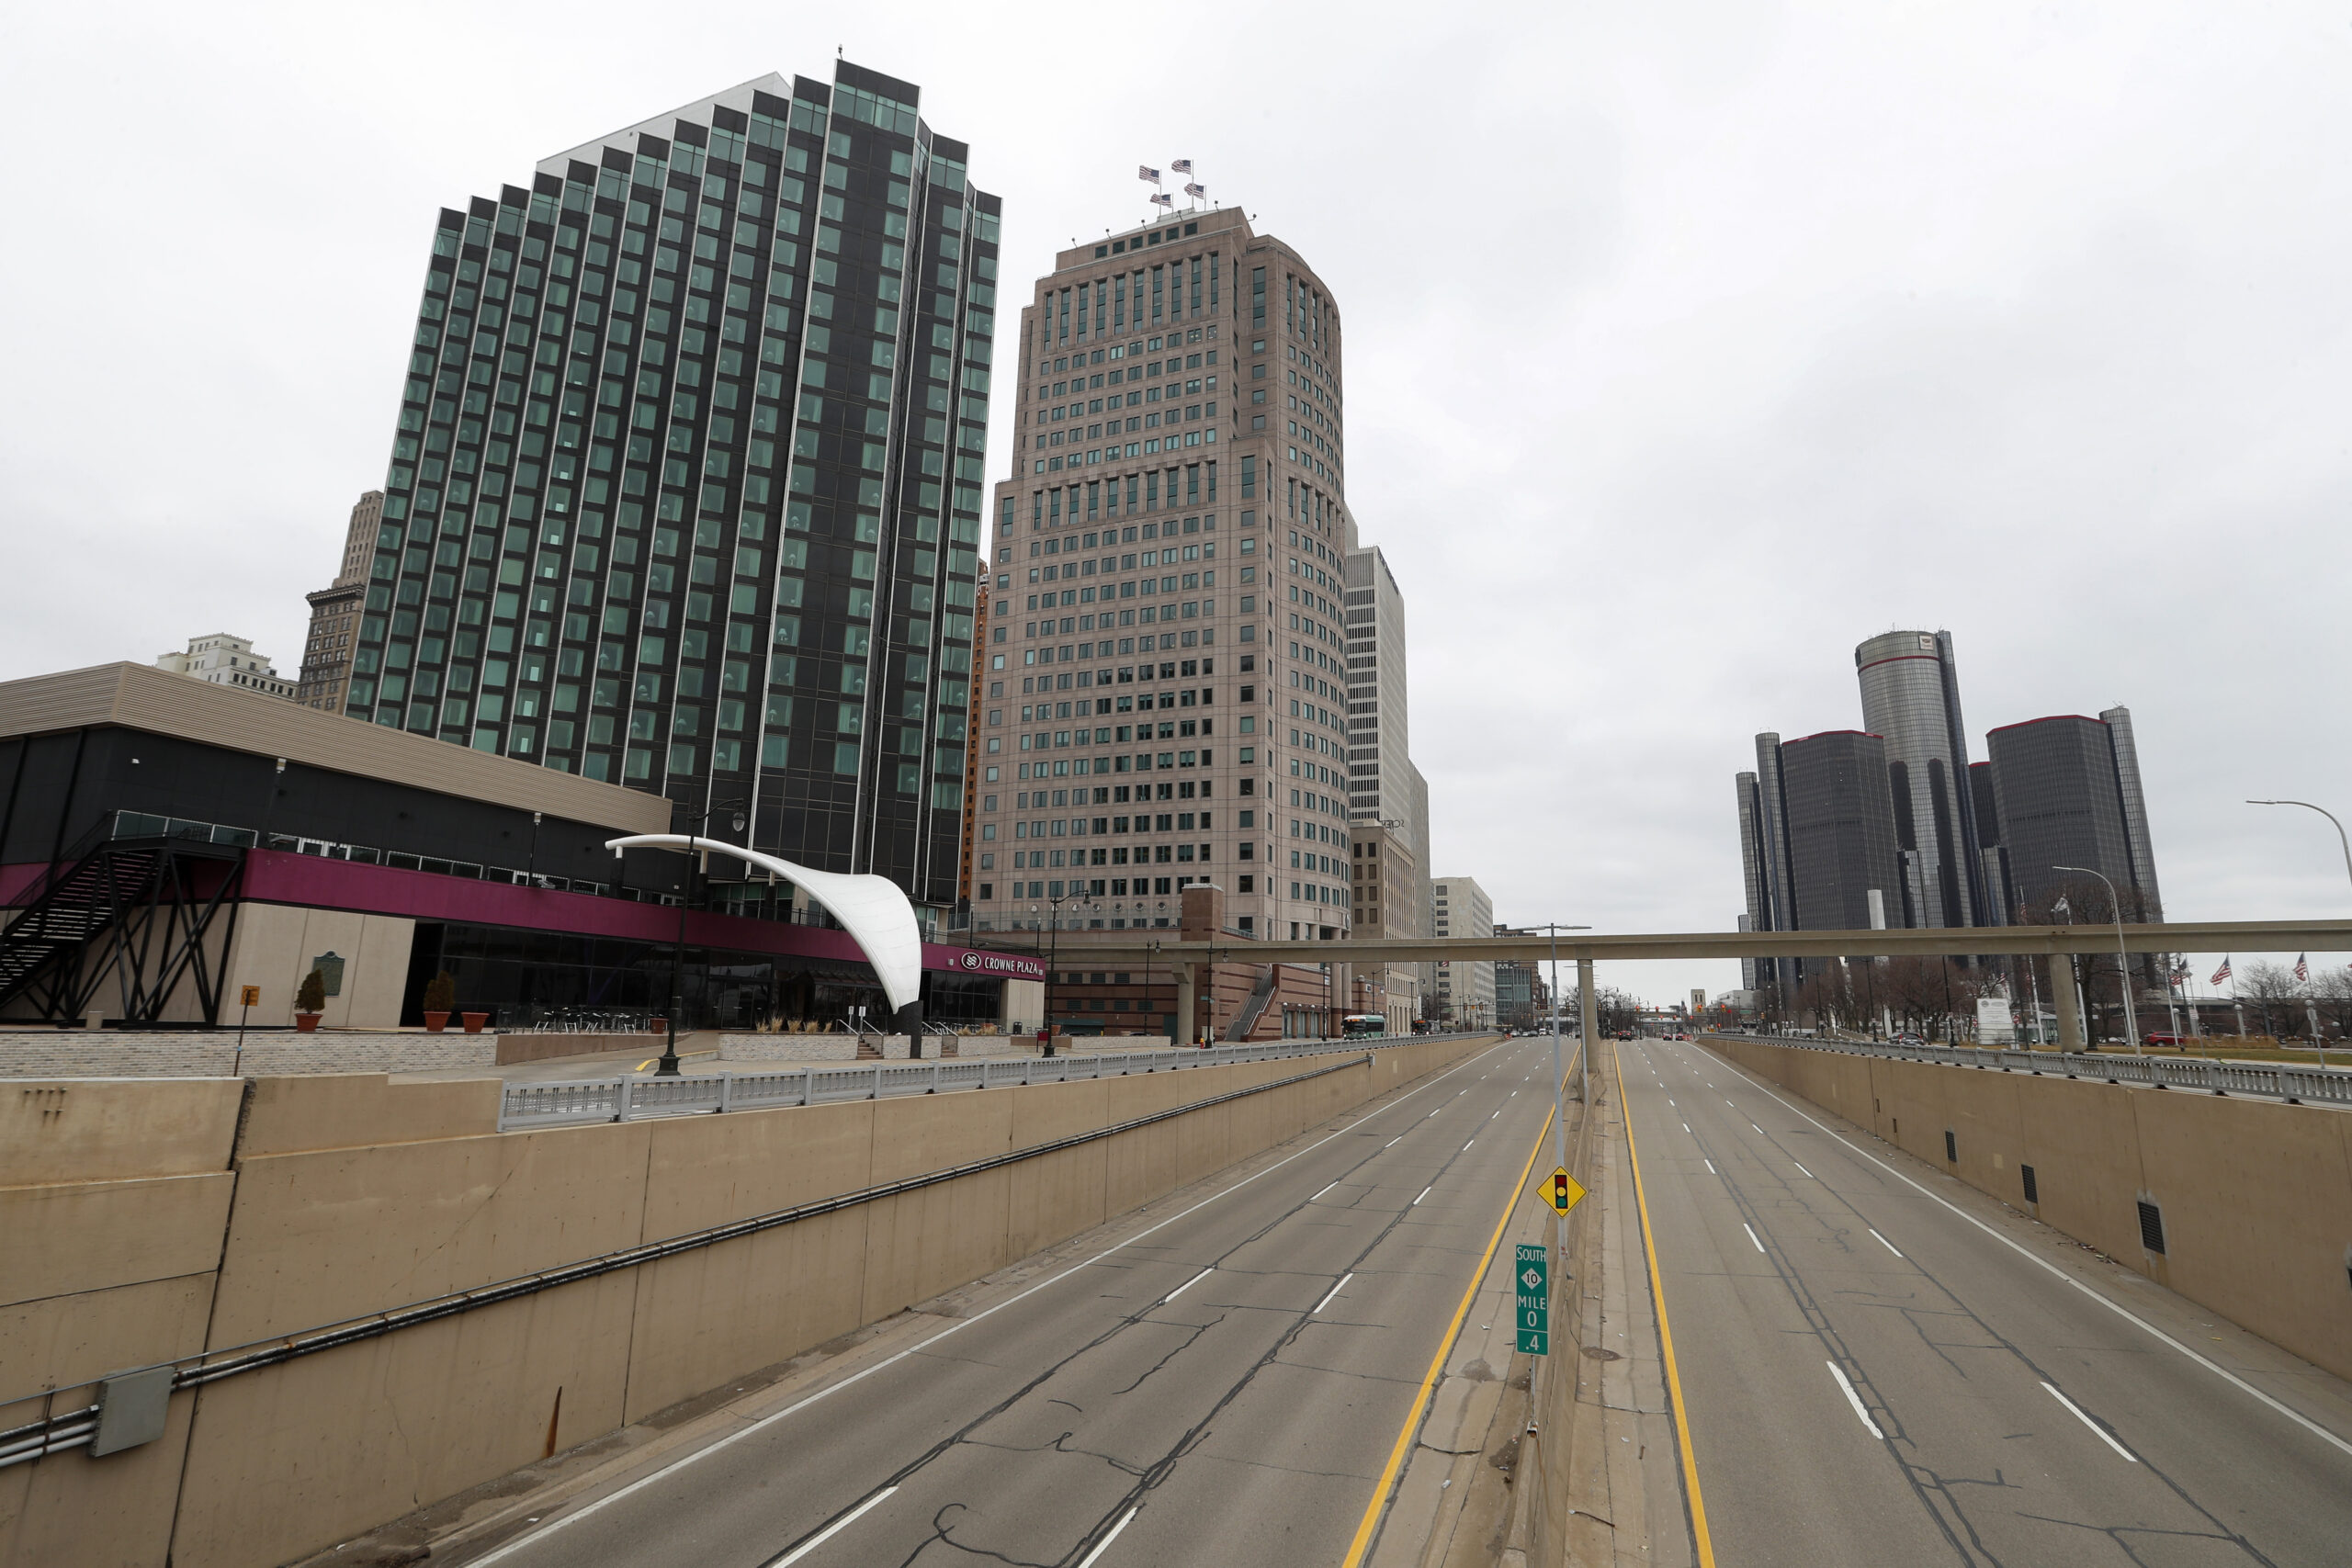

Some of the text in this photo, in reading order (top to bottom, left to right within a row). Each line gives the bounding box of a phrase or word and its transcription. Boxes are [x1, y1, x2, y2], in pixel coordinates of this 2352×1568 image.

[984, 957, 1037, 974] CROWNE PLAZA
[1517, 1247, 1546, 1262] SOUTH
[1526, 1273, 1538, 1284] 10
[1518, 1295, 1546, 1310] MILE
[1527, 1311, 1537, 1327] 0
